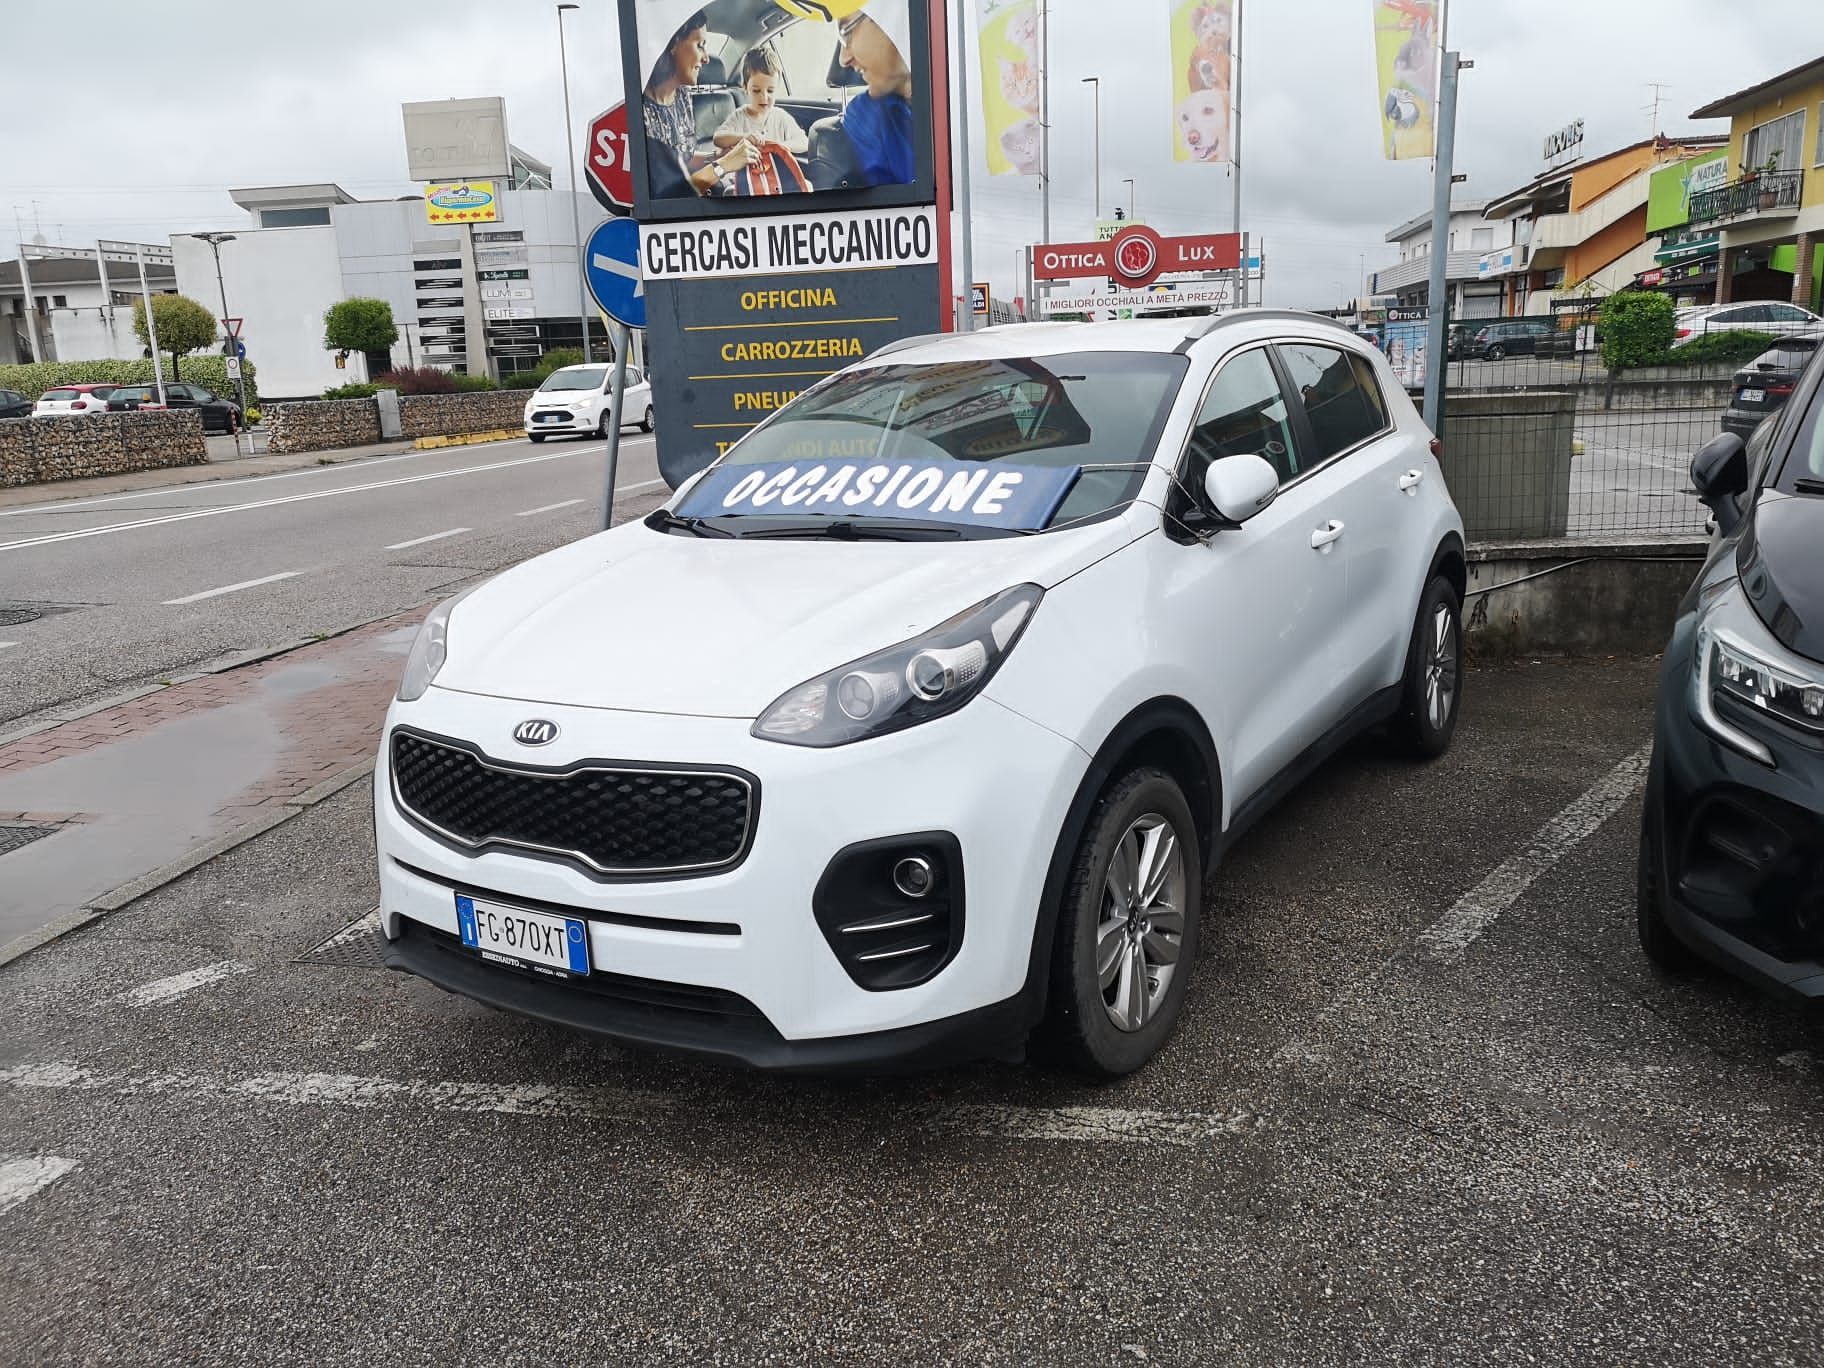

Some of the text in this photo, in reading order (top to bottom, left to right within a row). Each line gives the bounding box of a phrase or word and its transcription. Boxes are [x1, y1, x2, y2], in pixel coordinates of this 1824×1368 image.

[594, 128, 631, 172] ST
[646, 214, 931, 275] CERCASI MECCANICO
[1043, 252, 1106, 269] OTTICA
[741, 287, 838, 310] OFFICINA
[1050, 300, 1094, 310] MIGLIORI
[1096, 295, 1144, 307] OCCHIALI
[1146, 295, 1154, 305] A
[1187, 290, 1229, 302] PREZZO
[721, 337, 864, 361] CARROZZERIA
[723, 464, 1024, 514] OCCASIONE
[515, 720, 551, 741] KIA
